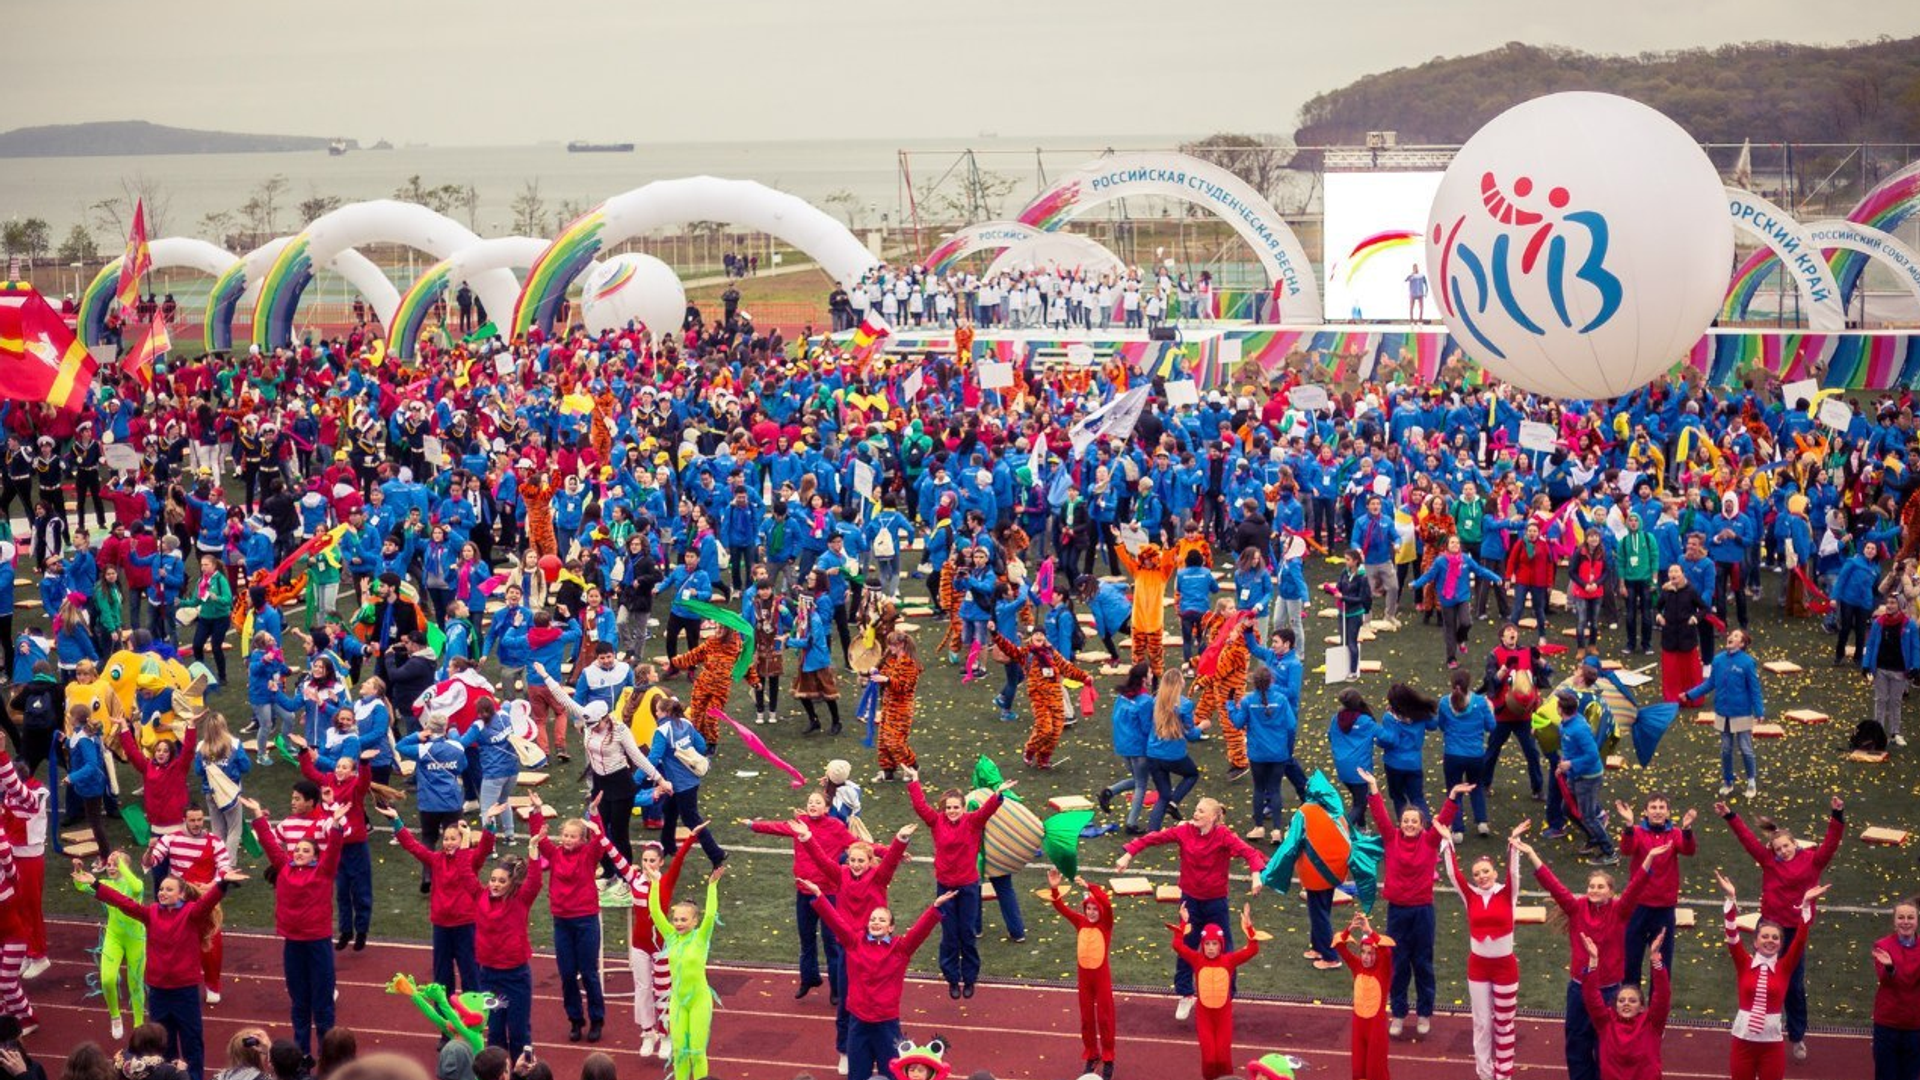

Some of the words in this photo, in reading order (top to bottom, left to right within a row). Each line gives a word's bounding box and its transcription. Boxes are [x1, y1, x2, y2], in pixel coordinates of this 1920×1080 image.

[1092, 167, 1186, 191] РОССИЙСКАЯ
[1188, 176, 1280, 250] СТУДЕНЧЕСКАЯ
[1274, 250, 1300, 296] ВЕСНА
[1811, 230, 1882, 249] РОССИЙСКИЙ
[1882, 244, 1909, 267] СОЮЗ
[1795, 253, 1831, 302] КРАЙ
